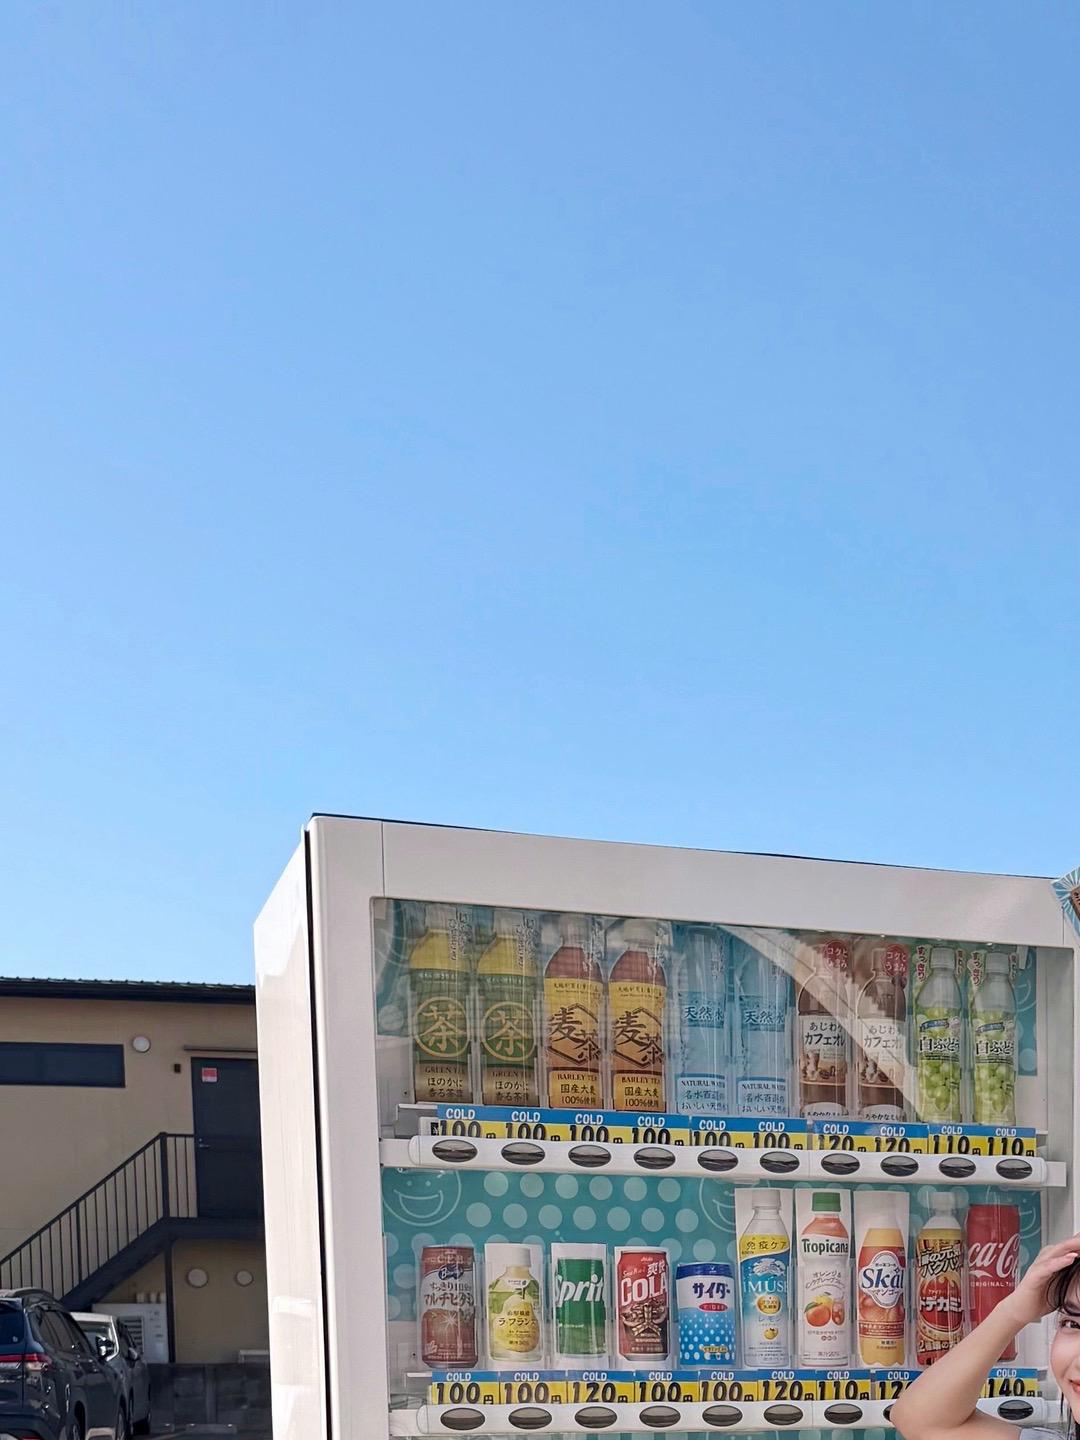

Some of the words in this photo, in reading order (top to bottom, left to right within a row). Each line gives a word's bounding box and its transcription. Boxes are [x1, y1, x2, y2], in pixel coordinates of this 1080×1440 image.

[886, 949, 907, 962] コクと
[916, 946, 927, 982] すっきり
[972, 951, 983, 986] すっきり
[685, 1006, 725, 1021] 天然水
[745, 1010, 785, 1025] 天然水
[420, 1003, 467, 1052] 茶
[488, 1009, 528, 1055] 茶
[550, 1007, 600, 1062] 麦茶
[613, 1010, 664, 1065] 麦茶
[804, 1032, 845, 1046] カフェオレ
[557, 1073, 585, 1081] BARLEY
[621, 1076, 649, 1084] BARLEY
[427, 1077, 463, 1089] ほのかに
[495, 1081, 529, 1091] ほのかに
[560, 1083, 597, 1096] 国産大麦
[624, 1086, 659, 1098] 国産大麦
[446, 1108, 476, 1120] COLD
[511, 1111, 541, 1122] COLD
[575, 1114, 604, 1125] COLD
[637, 1116, 666, 1127] COLD
[699, 1119, 727, 1131] COLD
[758, 1121, 785, 1132] COLD
[823, 1123, 850, 1134] COLD
[880, 1126, 906, 1137] COLD
[941, 1125, 963, 1135] COLD
[995, 1127, 1017, 1137] COLD
[746, 1239, 788, 1251] 免疫ケア
[801, 1238, 849, 1256] Tropicana
[621, 1273, 667, 1306] COLA
[692, 1282, 731, 1299] サイダー
[758, 1314, 782, 1322] レモン
[446, 1373, 472, 1382] COLD
[514, 1373, 540, 1382] COLD
[582, 1372, 607, 1382] COLD
[648, 1372, 673, 1382] COLD
[710, 1371, 735, 1381] COLD
[771, 1370, 795, 1380] COLD
[826, 1370, 850, 1380] COLD
[886, 1370, 910, 1380] COLD
[996, 1369, 1017, 1378] COLD
[436, 1382, 494, 1405] 100円
